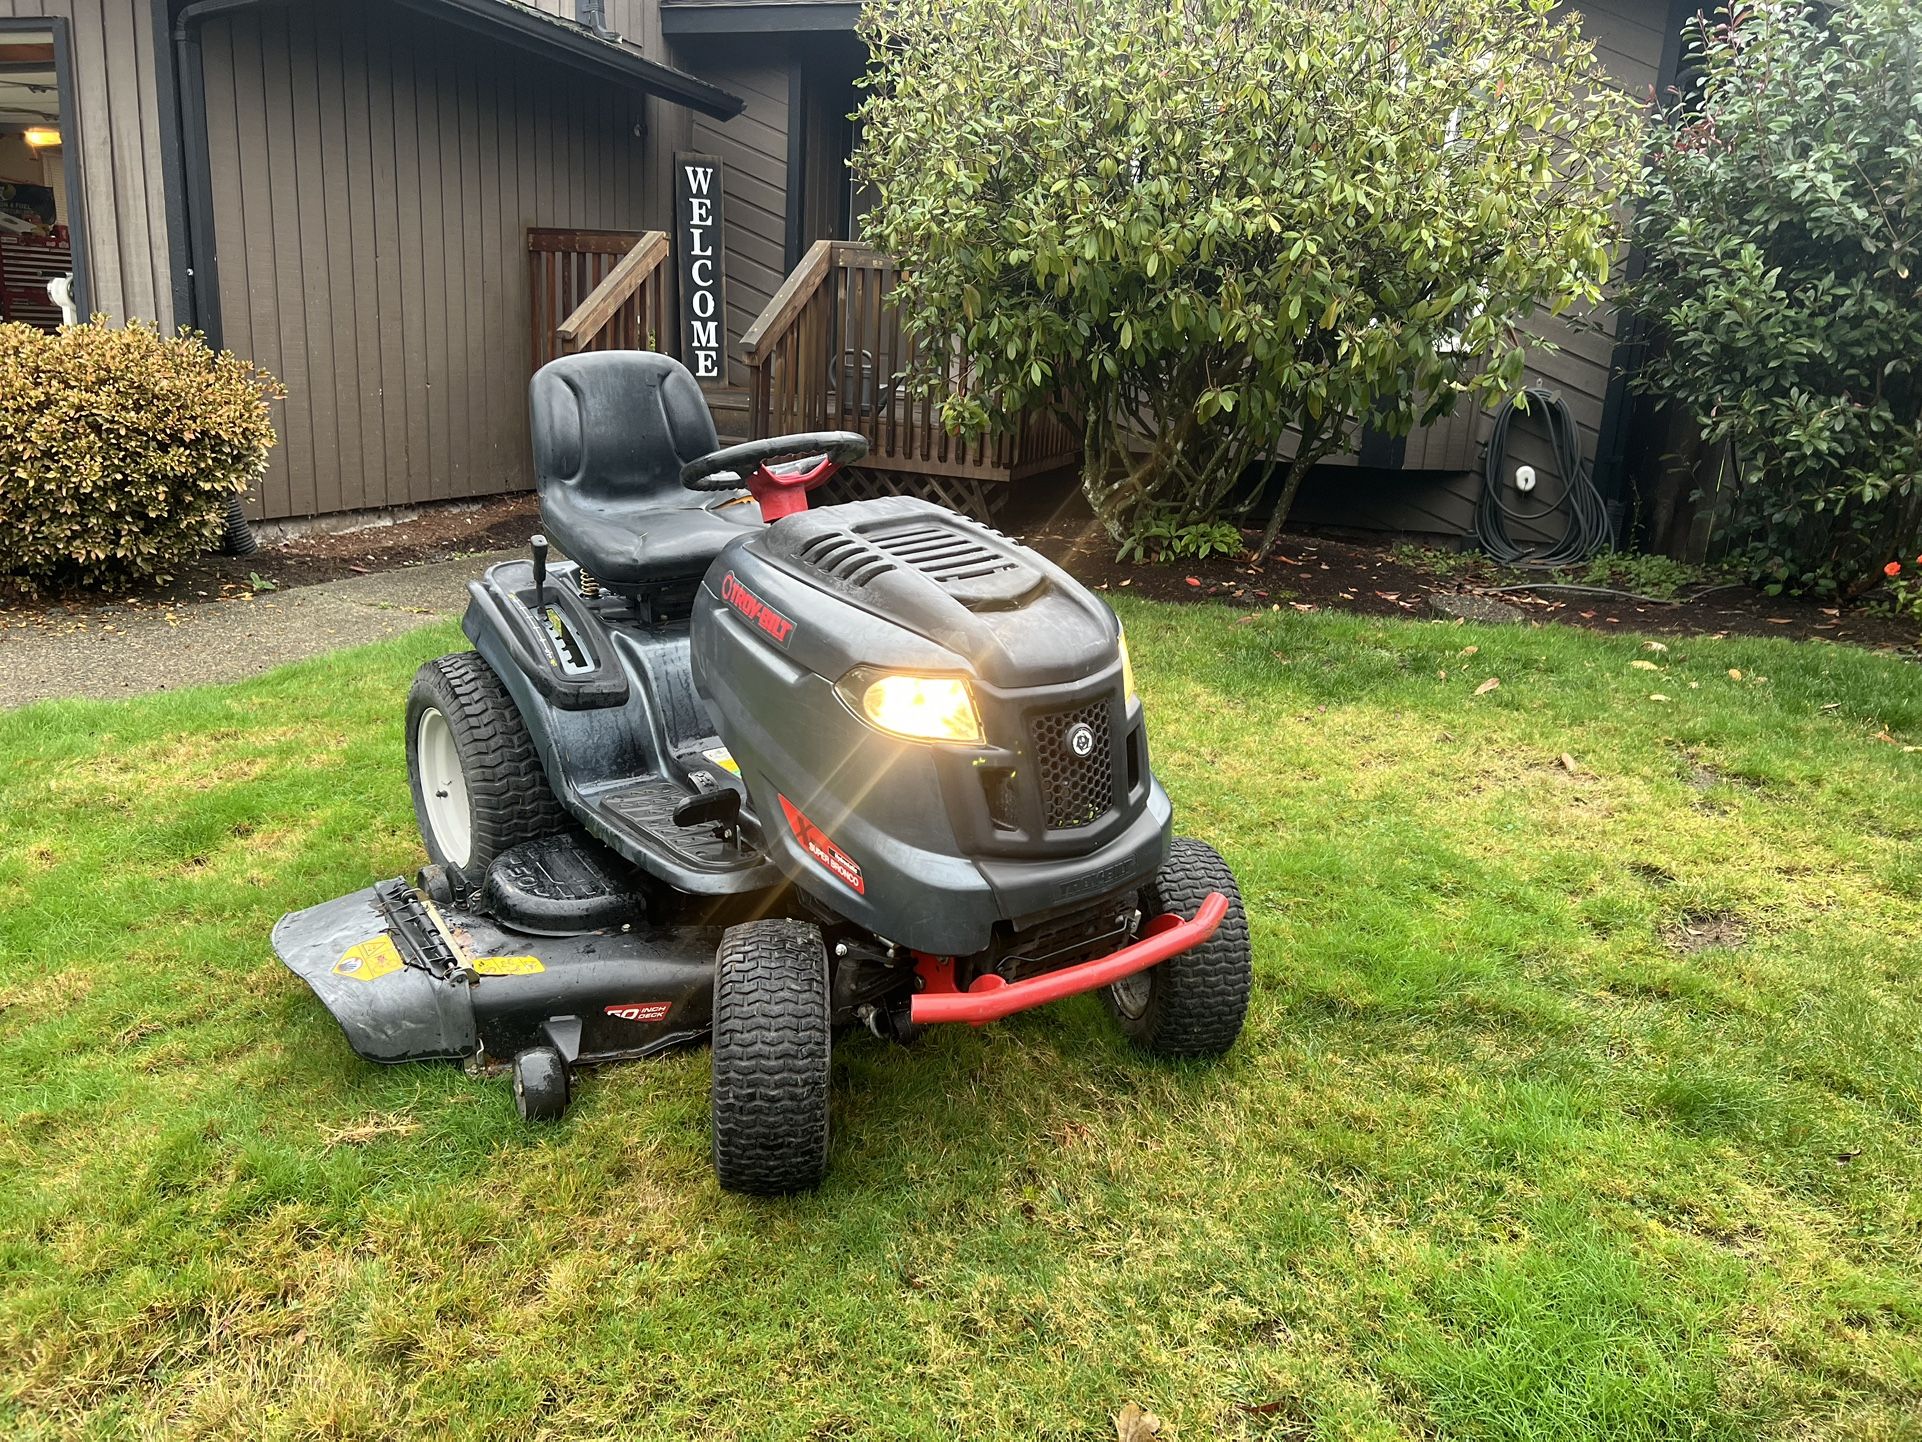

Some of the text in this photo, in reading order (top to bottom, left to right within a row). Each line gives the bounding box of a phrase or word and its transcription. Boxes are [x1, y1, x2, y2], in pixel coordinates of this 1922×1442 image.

[685, 166, 719, 377] WELCOME
[730, 582, 793, 641] TROY-BILT
[808, 841, 830, 864] SUPER
[830, 859, 860, 887] BRONCO
